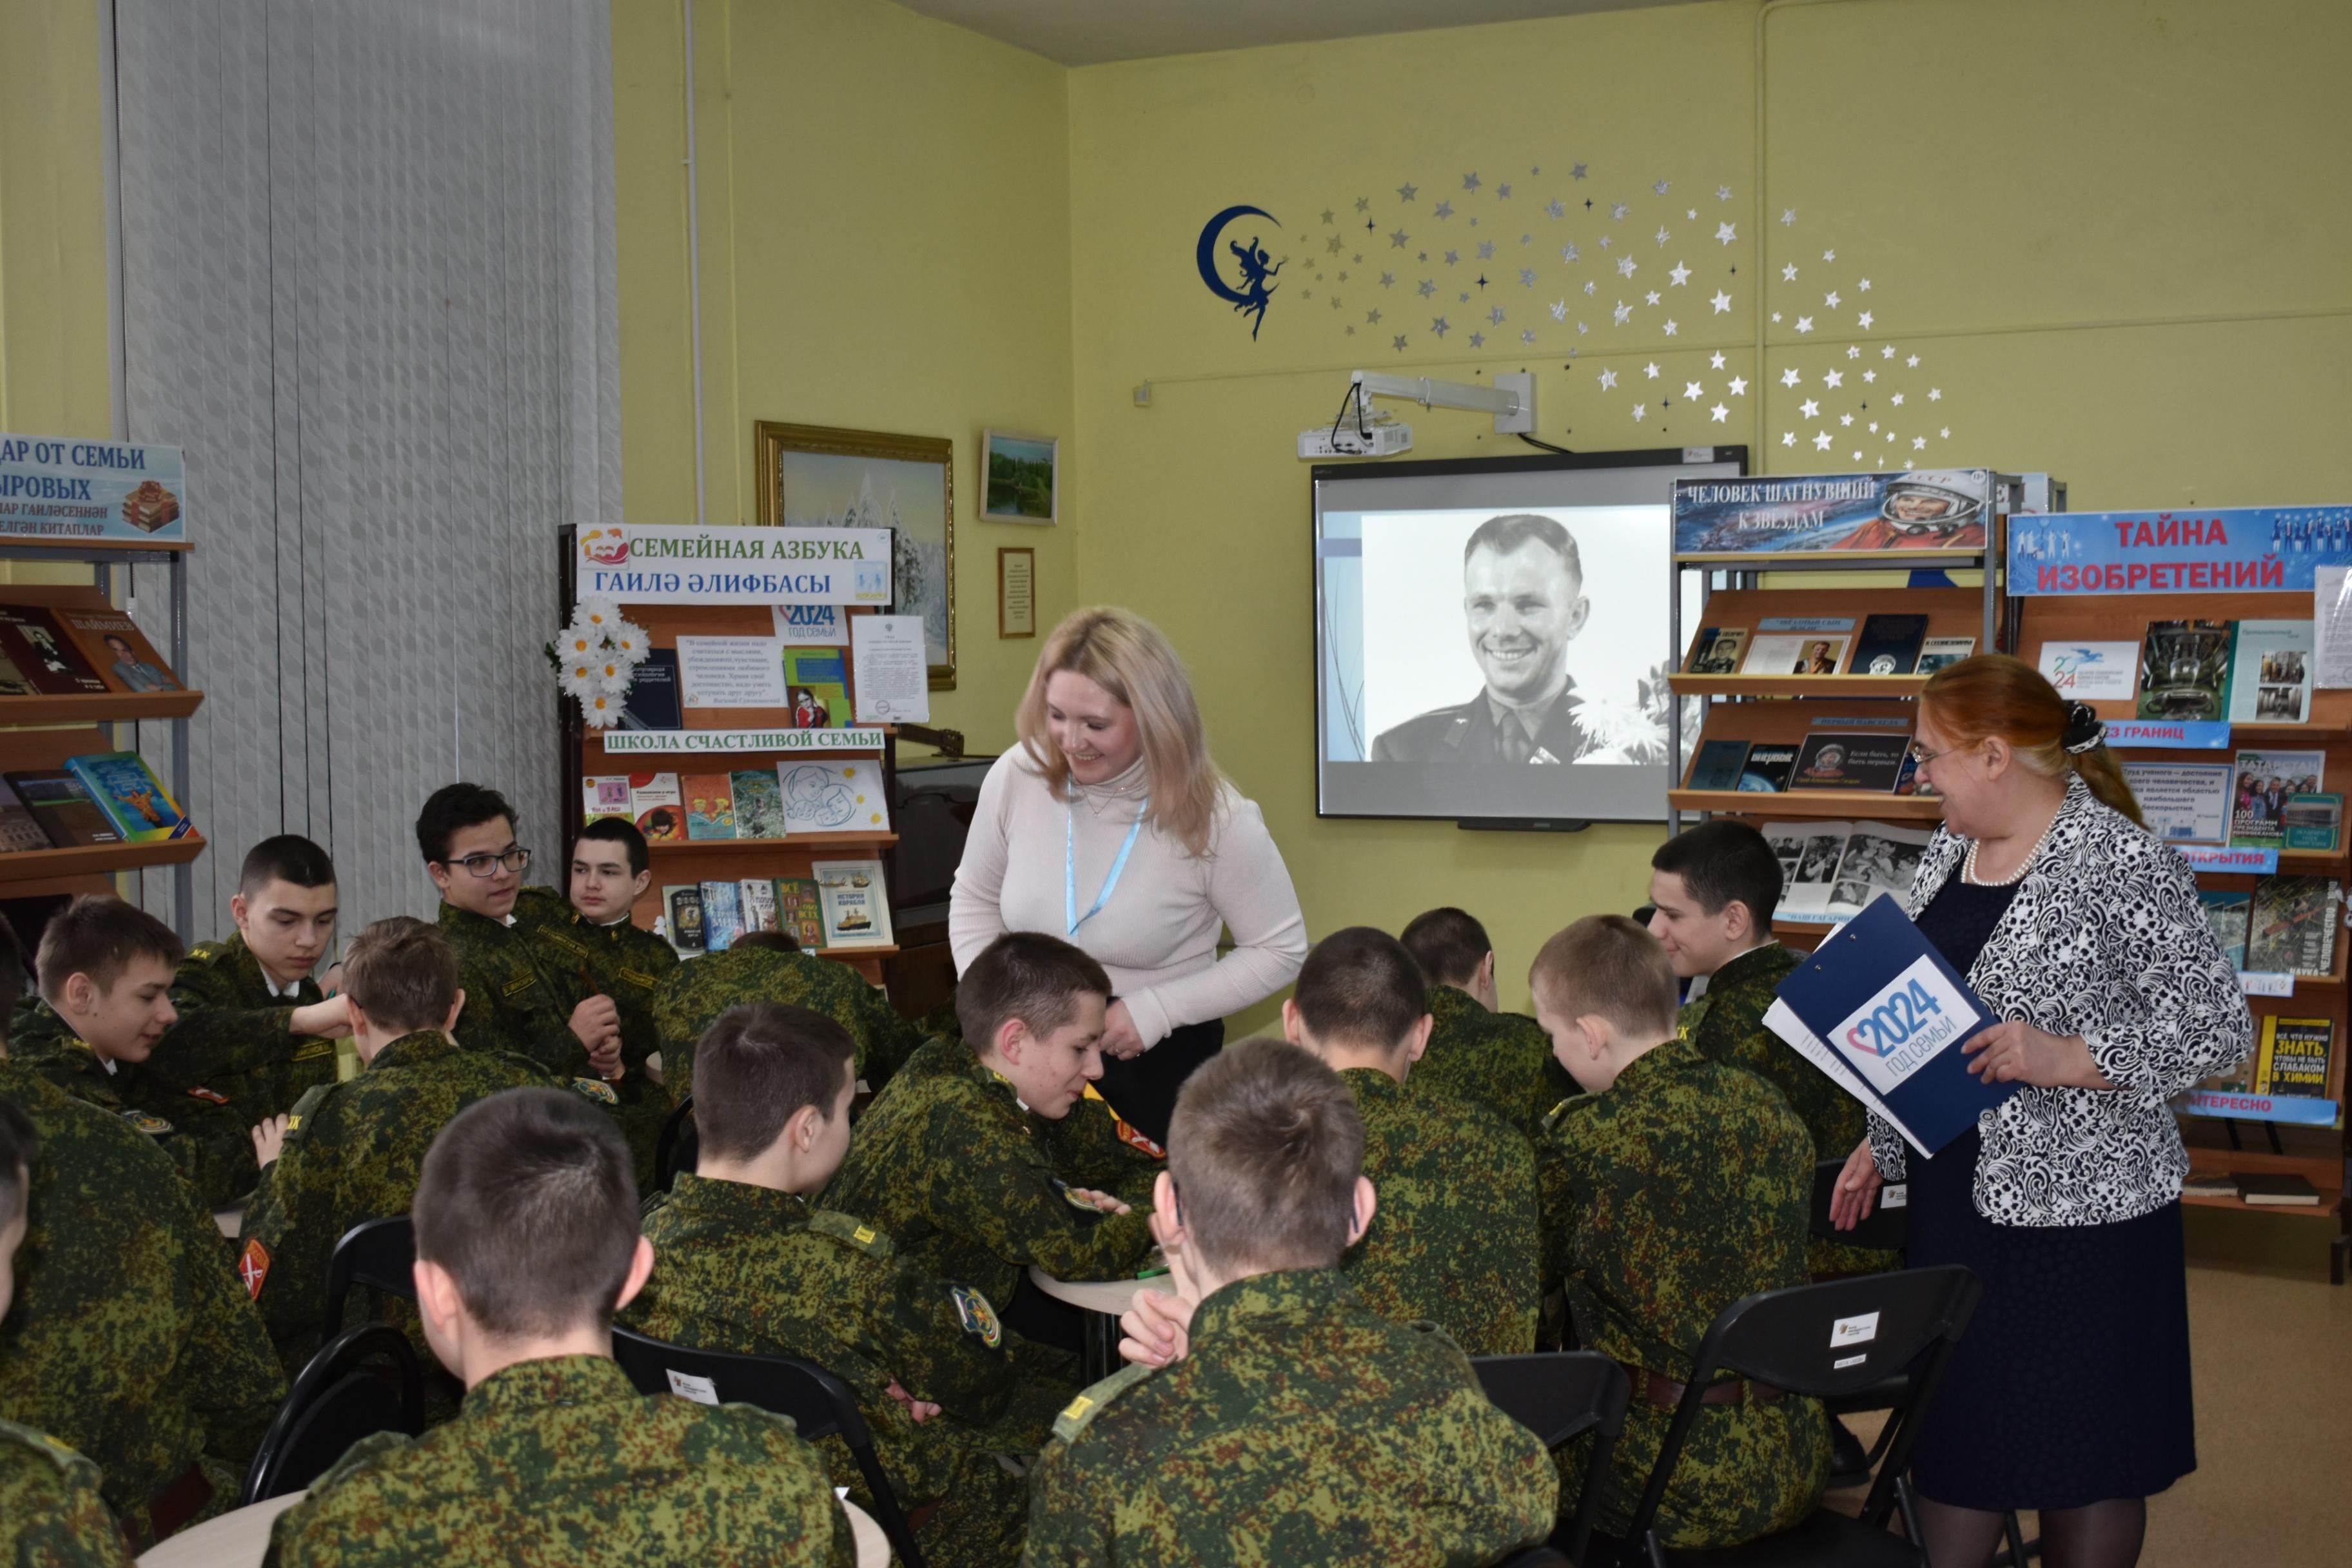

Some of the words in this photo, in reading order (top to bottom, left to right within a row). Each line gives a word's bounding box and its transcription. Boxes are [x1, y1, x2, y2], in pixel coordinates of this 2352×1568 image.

[35, 442, 65, 464] ОТ
[72, 444, 146, 470] СЕМЬИ
[1687, 484, 1762, 504] ЧЕЛОВЕК
[1765, 478, 1876, 502] ШАГНУВШИЙ
[40, 523, 104, 536] КИТАПЛАР
[1739, 513, 1749, 529] К
[1751, 508, 1824, 532] ЗВЁЗДАМ
[2115, 513, 2228, 548] ТАЙНА
[629, 534, 765, 559] СЕМЕЙНАЯ
[771, 540, 864, 560] АЗБУКА
[2037, 553, 2284, 592] ИЗОБРЕТЕНИЙ
[595, 572, 681, 593] ГАИЛӘ
[688, 573, 831, 594] ӘЛИФБАСЫ
[787, 605, 836, 625] 2024
[2053, 671, 2076, 689] 24
[607, 734, 681, 749] ШКОЛА
[685, 730, 814, 749] СЧАСТЛИВОЙ
[817, 732, 882, 747] СЕМЬИ
[2105, 727, 2121, 738] ЕЗ
[2124, 726, 2184, 740] ГРАНИЦ
[2240, 760, 2319, 770] ТАТАРСТАН
[2234, 809, 2254, 819] 100
[781, 881, 800, 894] ВСЁ
[2320, 906, 2337, 971] ЧЕЛОВЕЧЕСТВО
[1856, 977, 1942, 1059] 2024
[2272, 1071, 2280, 1082] В
[2273, 1063, 2325, 1073] СЛАБАКОМ
